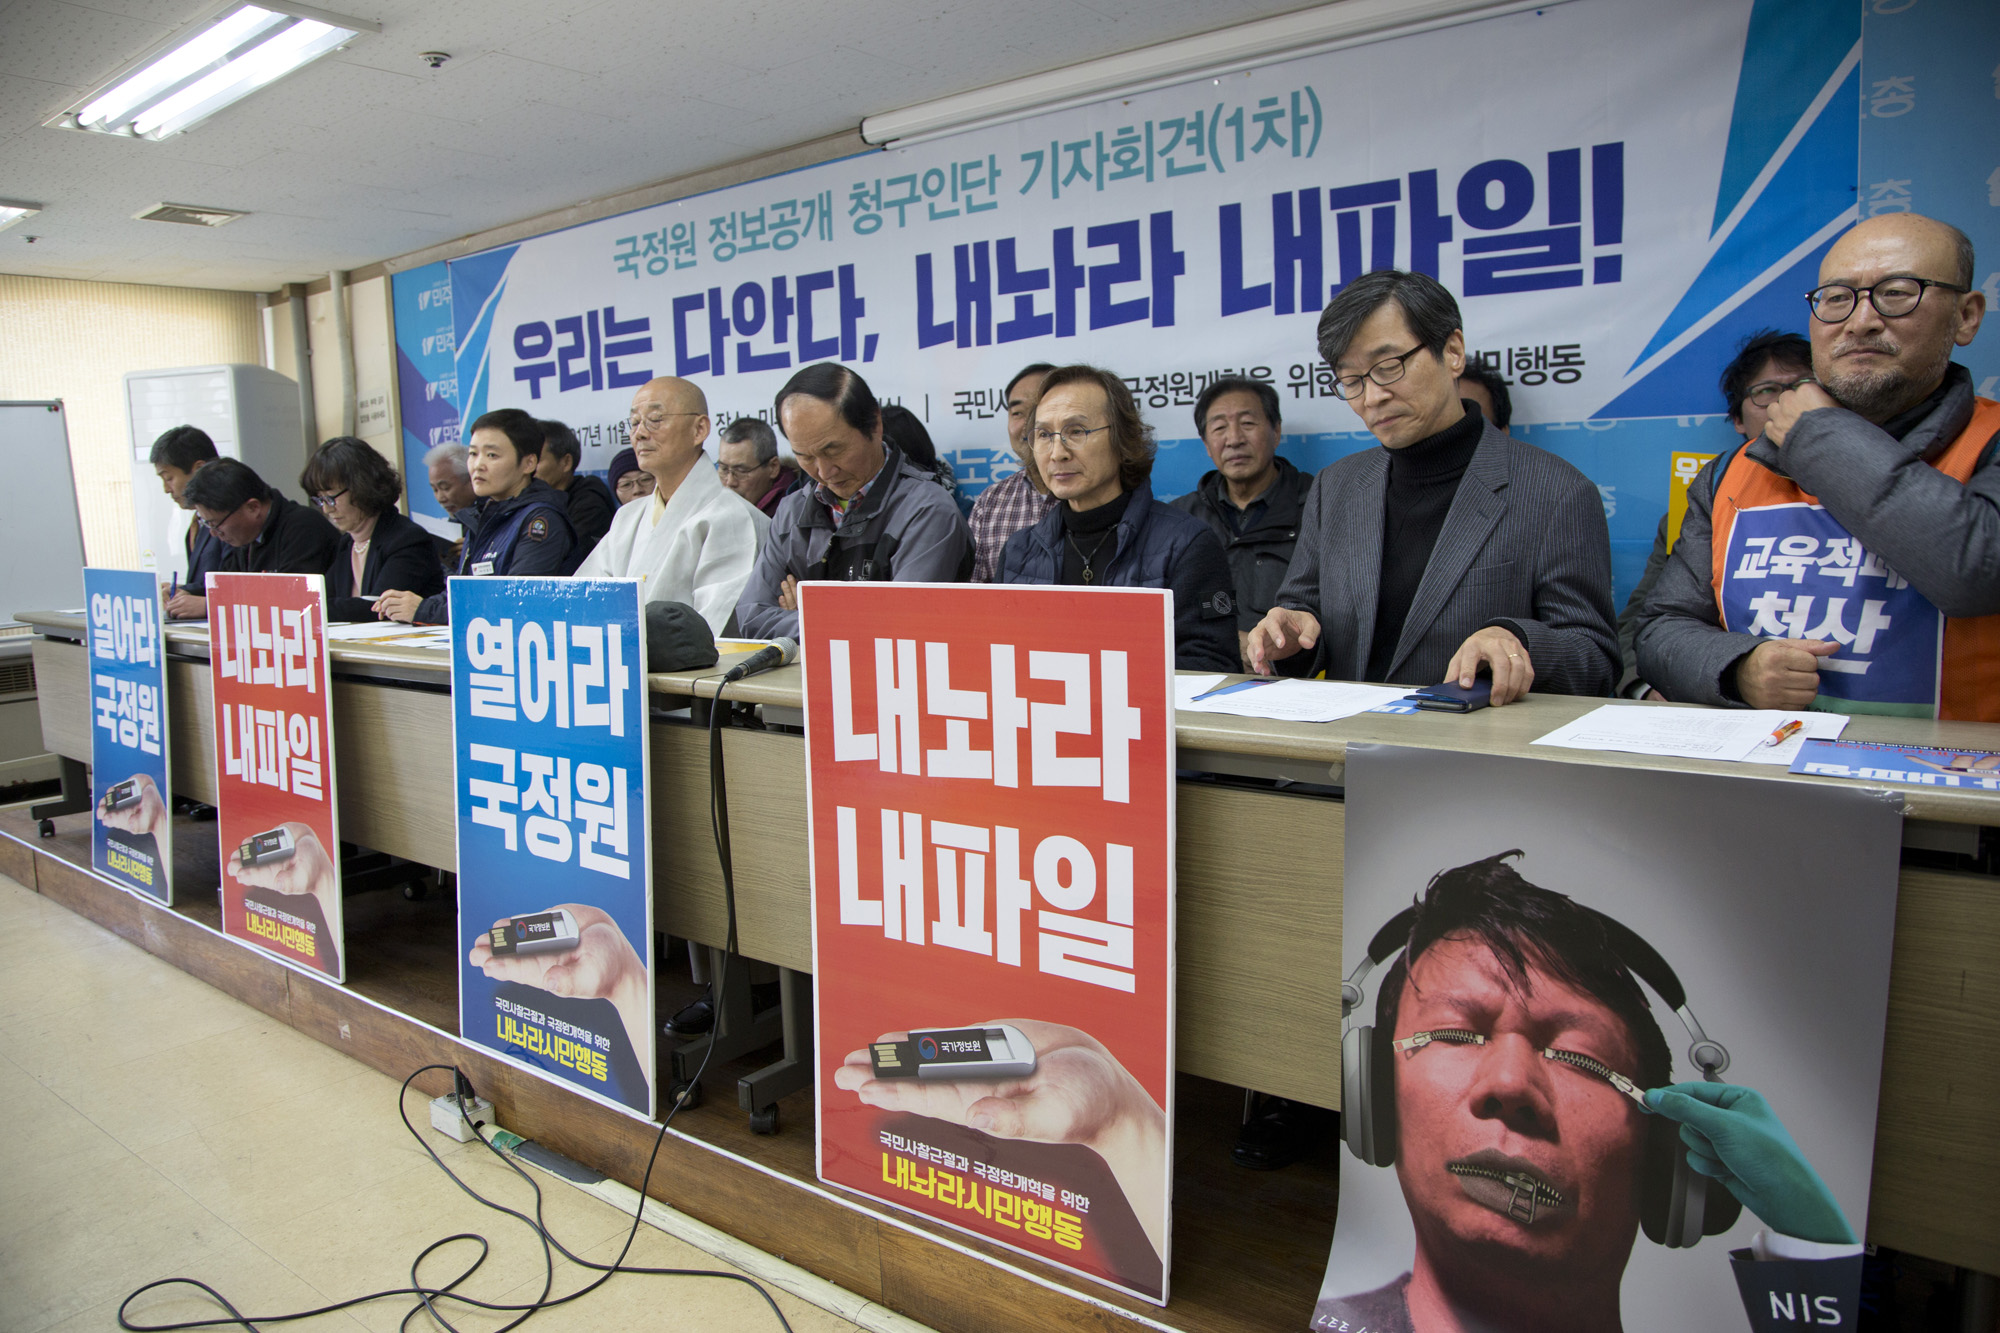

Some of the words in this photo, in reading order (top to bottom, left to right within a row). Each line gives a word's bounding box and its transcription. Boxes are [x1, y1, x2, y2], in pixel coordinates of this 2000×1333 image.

[614, 221, 698, 279] 국정원
[708, 189, 833, 262] 정보공개
[848, 154, 1002, 235] 청구인단
[1019, 86, 1323, 200] 기자회견(1차)
[512, 305, 654, 399] 우리는
[672, 263, 880, 377] 다안다,
[915, 210, 1186, 350] 내놔라
[1219, 141, 1625, 318] 내파일!
[571, 423, 601, 447] 17년
[92, 593, 156, 668] 열어라
[218, 604, 317, 693] 내놔라
[96, 674, 160, 756] 국정원
[466, 617, 629, 737] 열어라
[223, 703, 323, 801] 내파일
[829, 638, 1141, 803] 내놔라
[469, 742, 630, 880] 국정원
[246, 911, 315, 957] 내놔라시민행동
[836, 805, 1136, 993] 내파일
[497, 1014, 608, 1082] 내놔라시민행동
[594, 1034, 611, 1051] 위한
[941, 1040, 981, 1053] 국가정보원
[880, 1131, 969, 1173] 국민사찰근절과
[973, 1161, 1055, 1202] 국정원개혁을
[1060, 1189, 1090, 1213] 위한
[882, 1152, 1084, 1251] 내놔라시민행동
[1317, 1314, 1350, 1333] LEE
[1769, 1290, 1842, 1325] NIS
